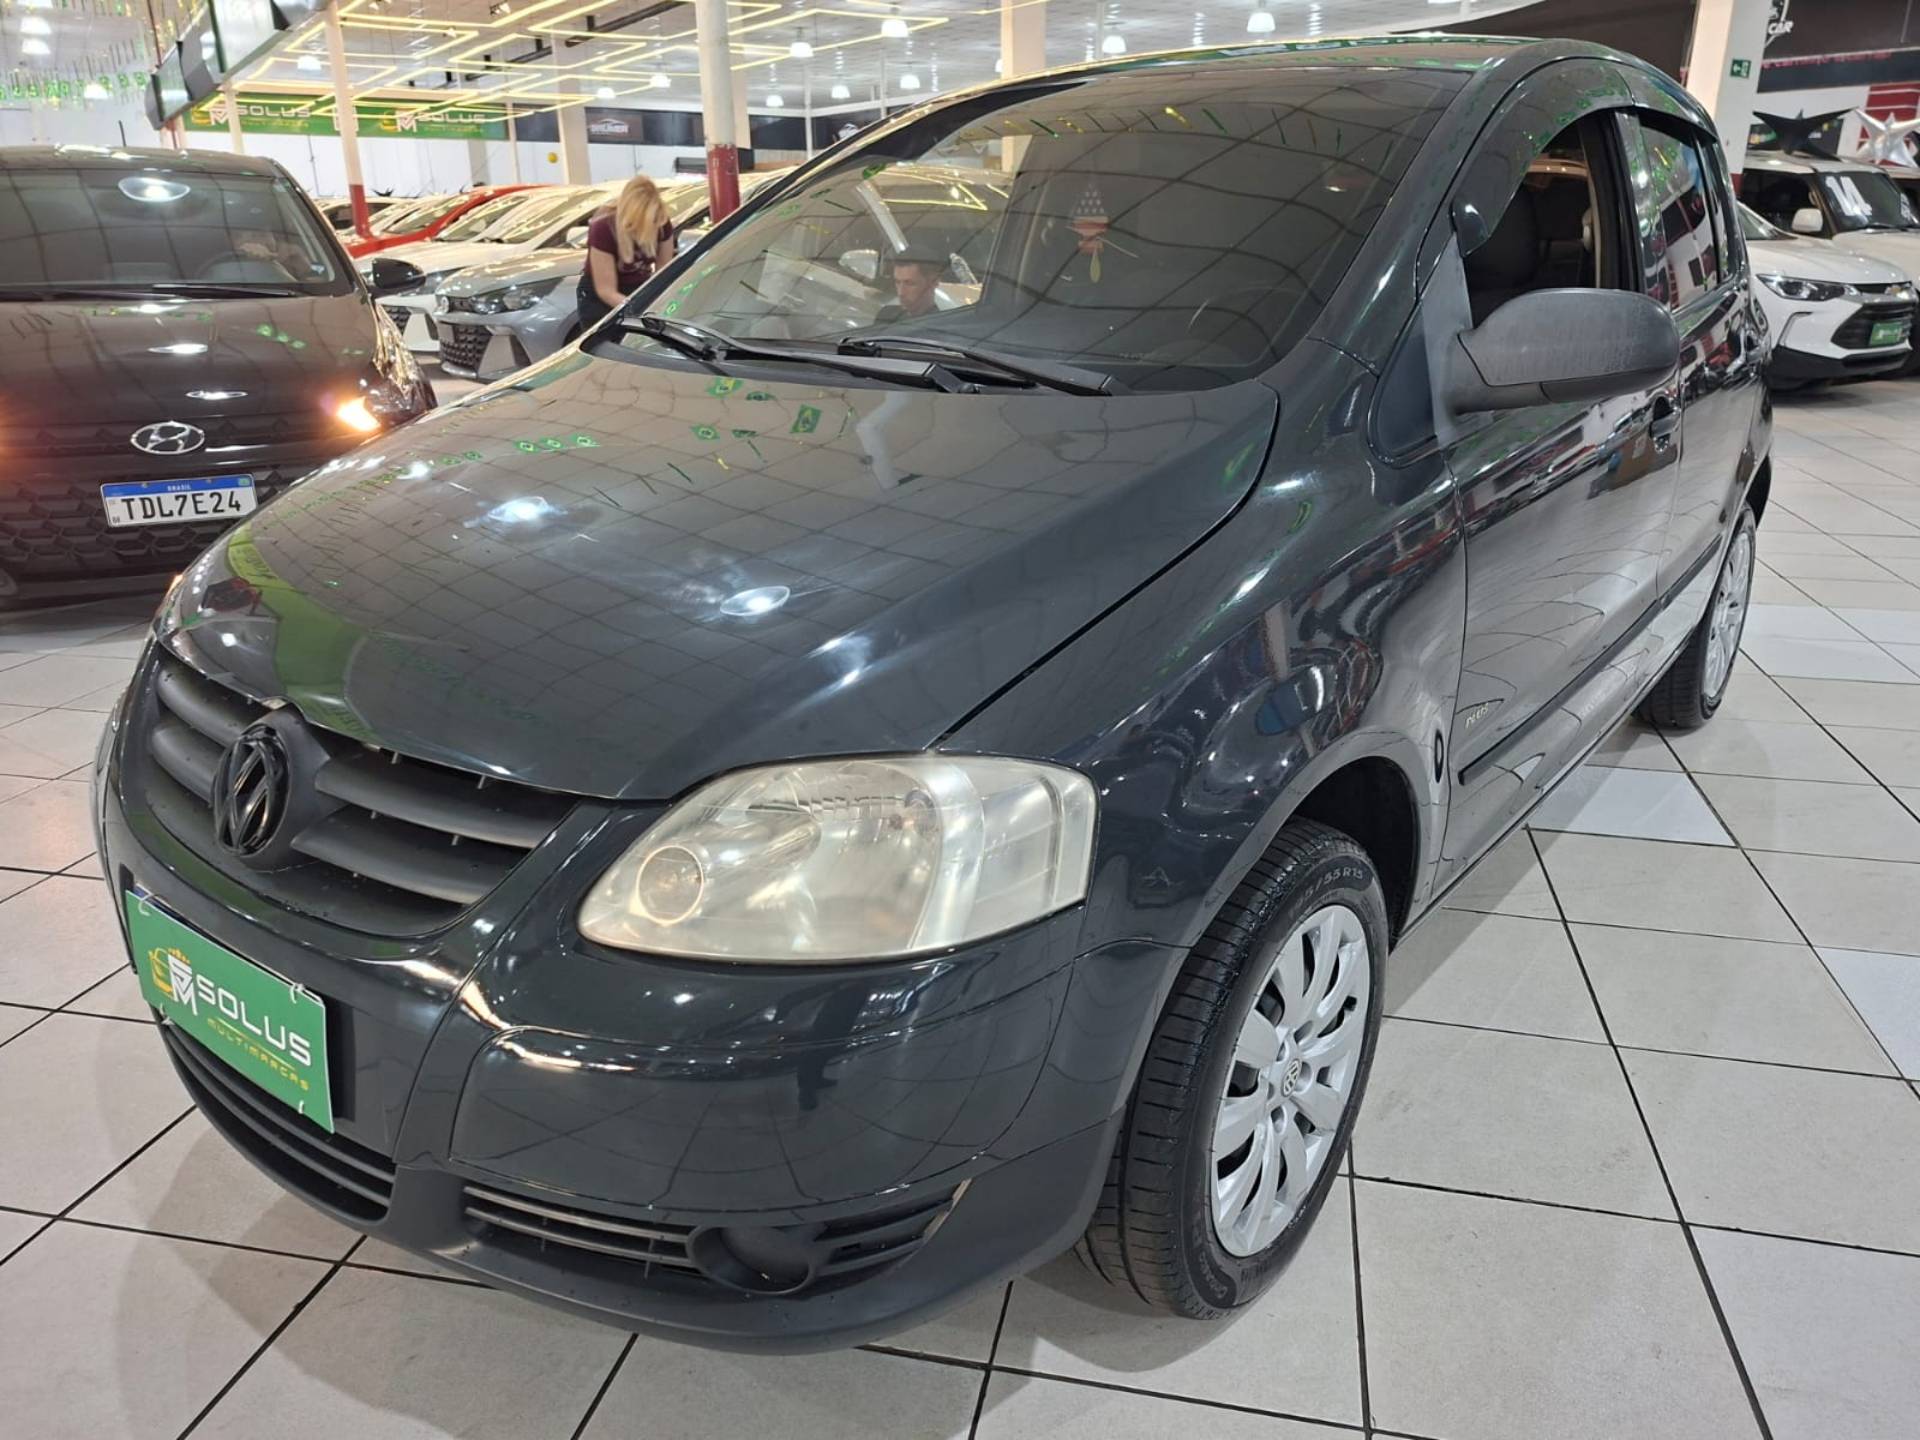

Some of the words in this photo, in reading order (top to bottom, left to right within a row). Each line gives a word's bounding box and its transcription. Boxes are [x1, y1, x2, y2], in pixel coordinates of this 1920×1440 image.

[167, 484, 192, 492] BRASIL
[120, 490, 242, 520] TDL7E24
[196, 973, 312, 1067] SOLUS
